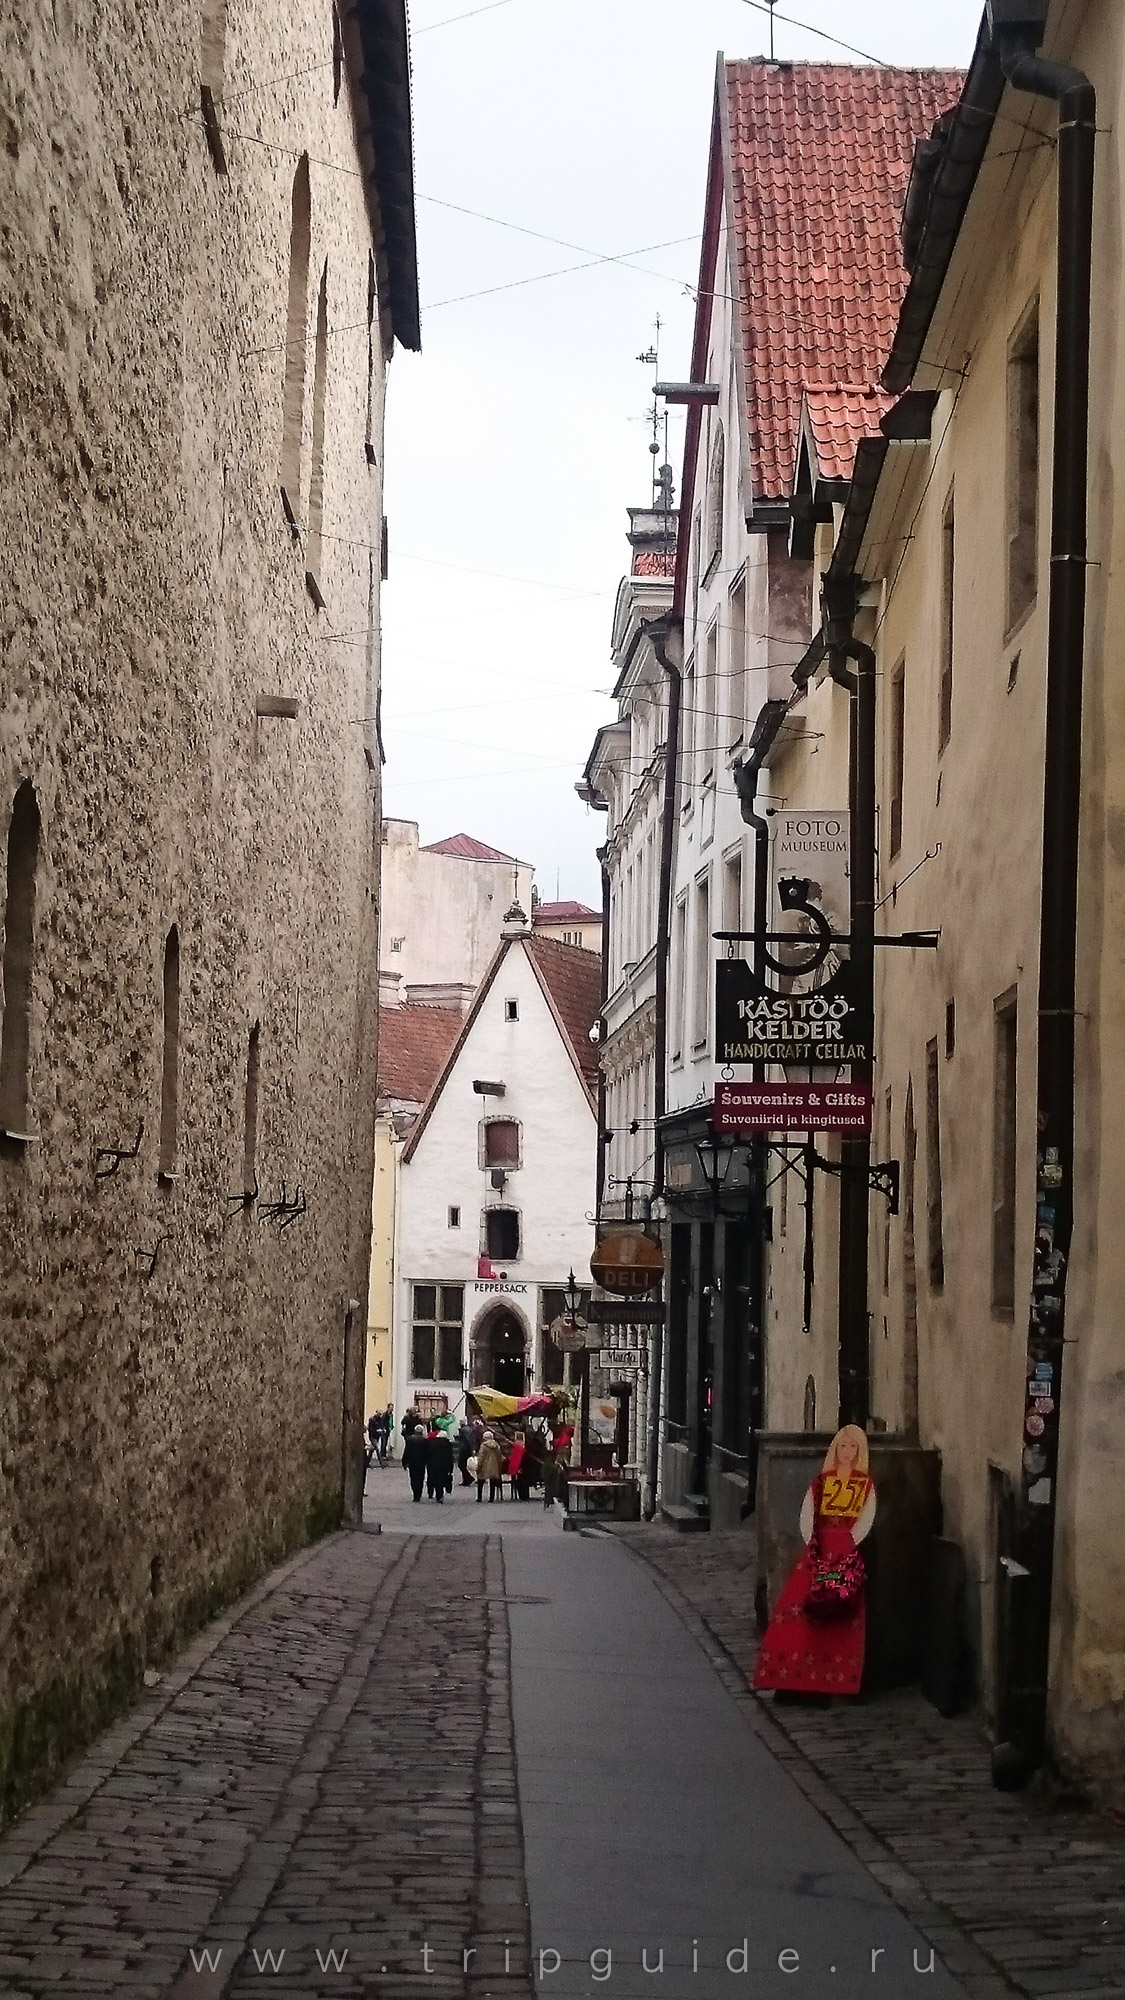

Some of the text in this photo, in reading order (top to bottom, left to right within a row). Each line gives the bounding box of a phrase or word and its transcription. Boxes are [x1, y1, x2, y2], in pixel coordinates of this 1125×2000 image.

[781, 841, 847, 852] MUUSEUM
[746, 1020, 844, 1040] KELDER
[723, 1042, 867, 1060] HANDICRAFT CELLAR
[721, 1092, 866, 1106] Souvenirs & Gifts
[721, 1113, 865, 1127] Suveniirid ja kingitused
[604, 1270, 649, 1288] DELI
[474, 1283, 528, 1294] PEPPERSACK
